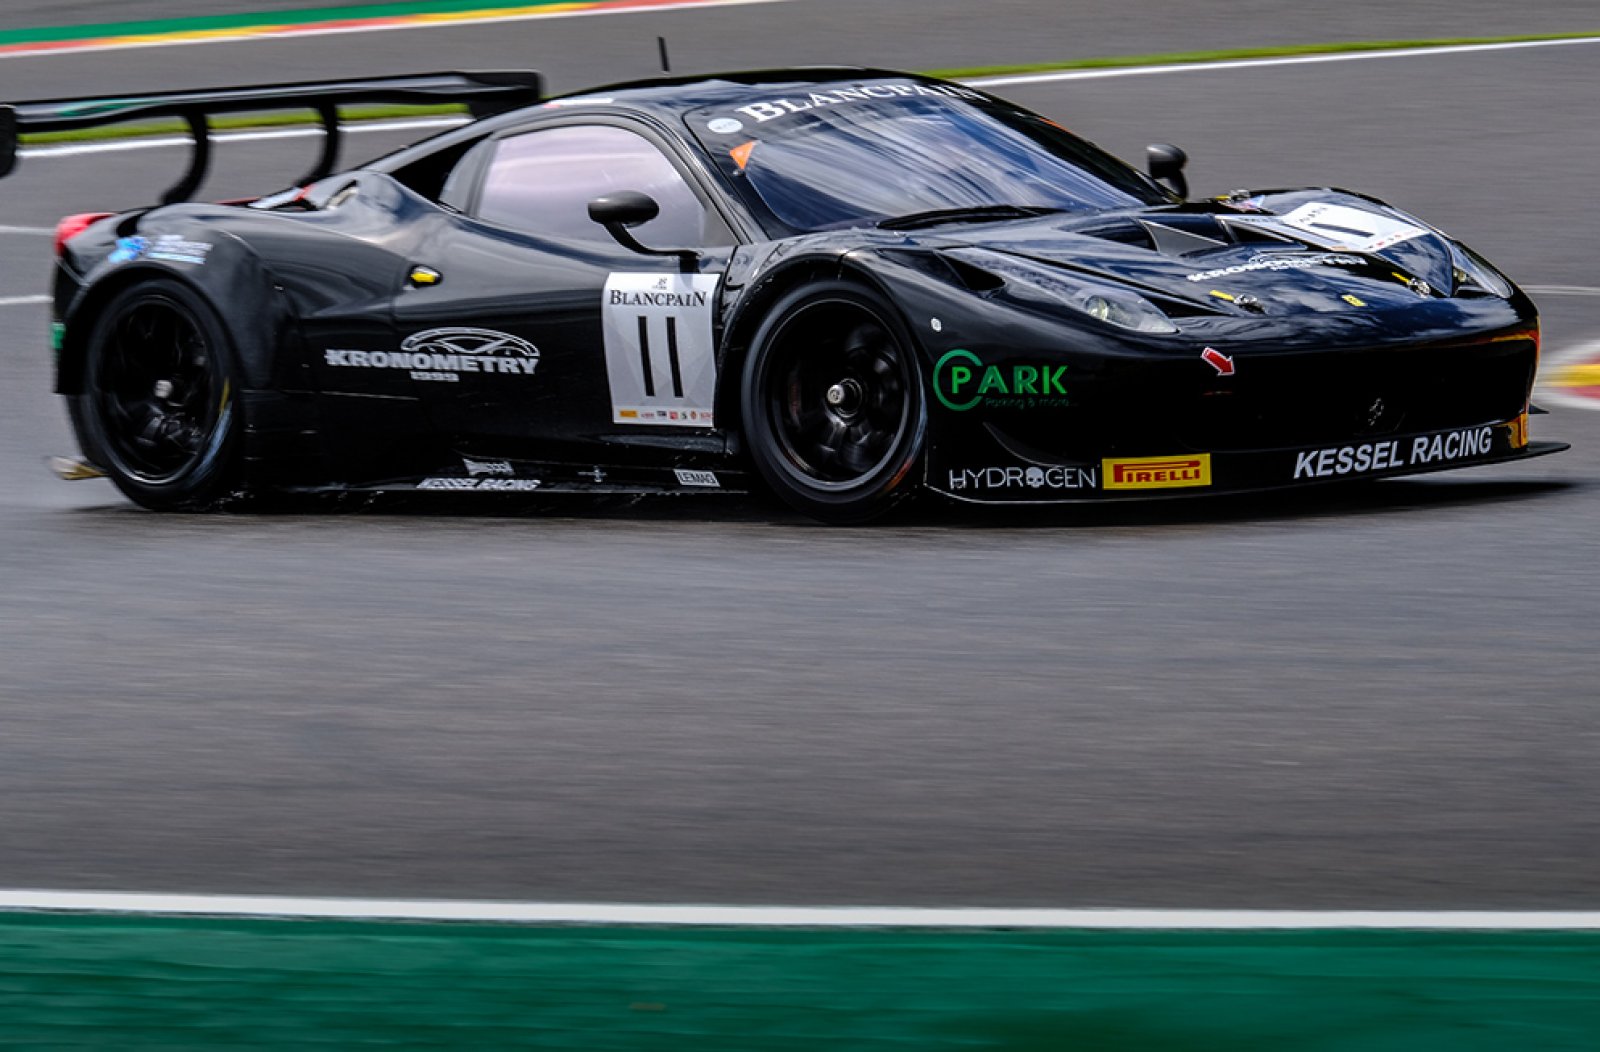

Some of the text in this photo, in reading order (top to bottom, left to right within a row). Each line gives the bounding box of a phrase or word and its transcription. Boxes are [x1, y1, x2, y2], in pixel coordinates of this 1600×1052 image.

[610, 289, 707, 307] BLANCPAIN
[324, 349, 539, 375] KRONOMETRY
[637, 315, 684, 398] 11
[1293, 426, 1493, 479] KESSEL RACING
[1112, 460, 1201, 483] PIRELLI
